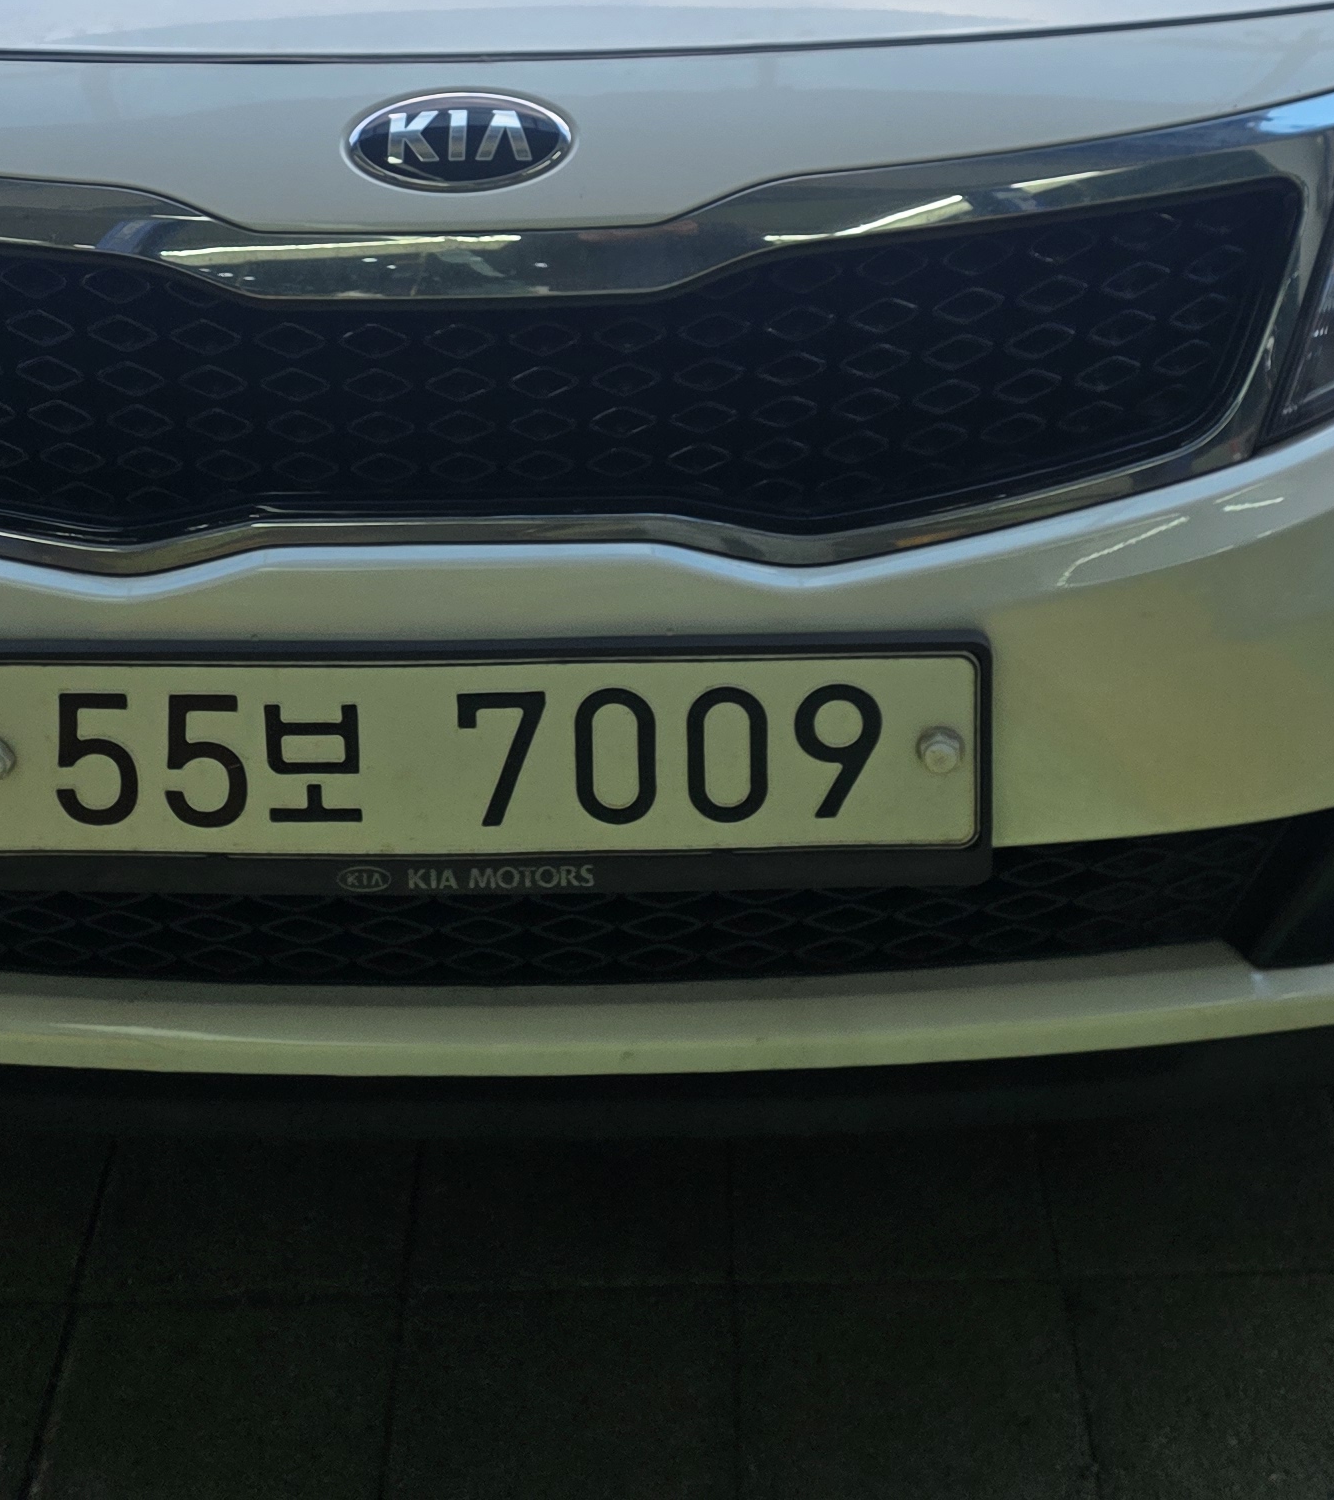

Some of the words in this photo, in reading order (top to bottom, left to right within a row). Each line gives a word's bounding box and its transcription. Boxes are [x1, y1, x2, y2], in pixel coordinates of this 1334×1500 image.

[386, 108, 533, 165] KIA
[54, 691, 364, 830] 55보
[455, 683, 884, 829] 7009
[407, 867, 459, 890] KIA
[468, 864, 596, 890] MOTORS
